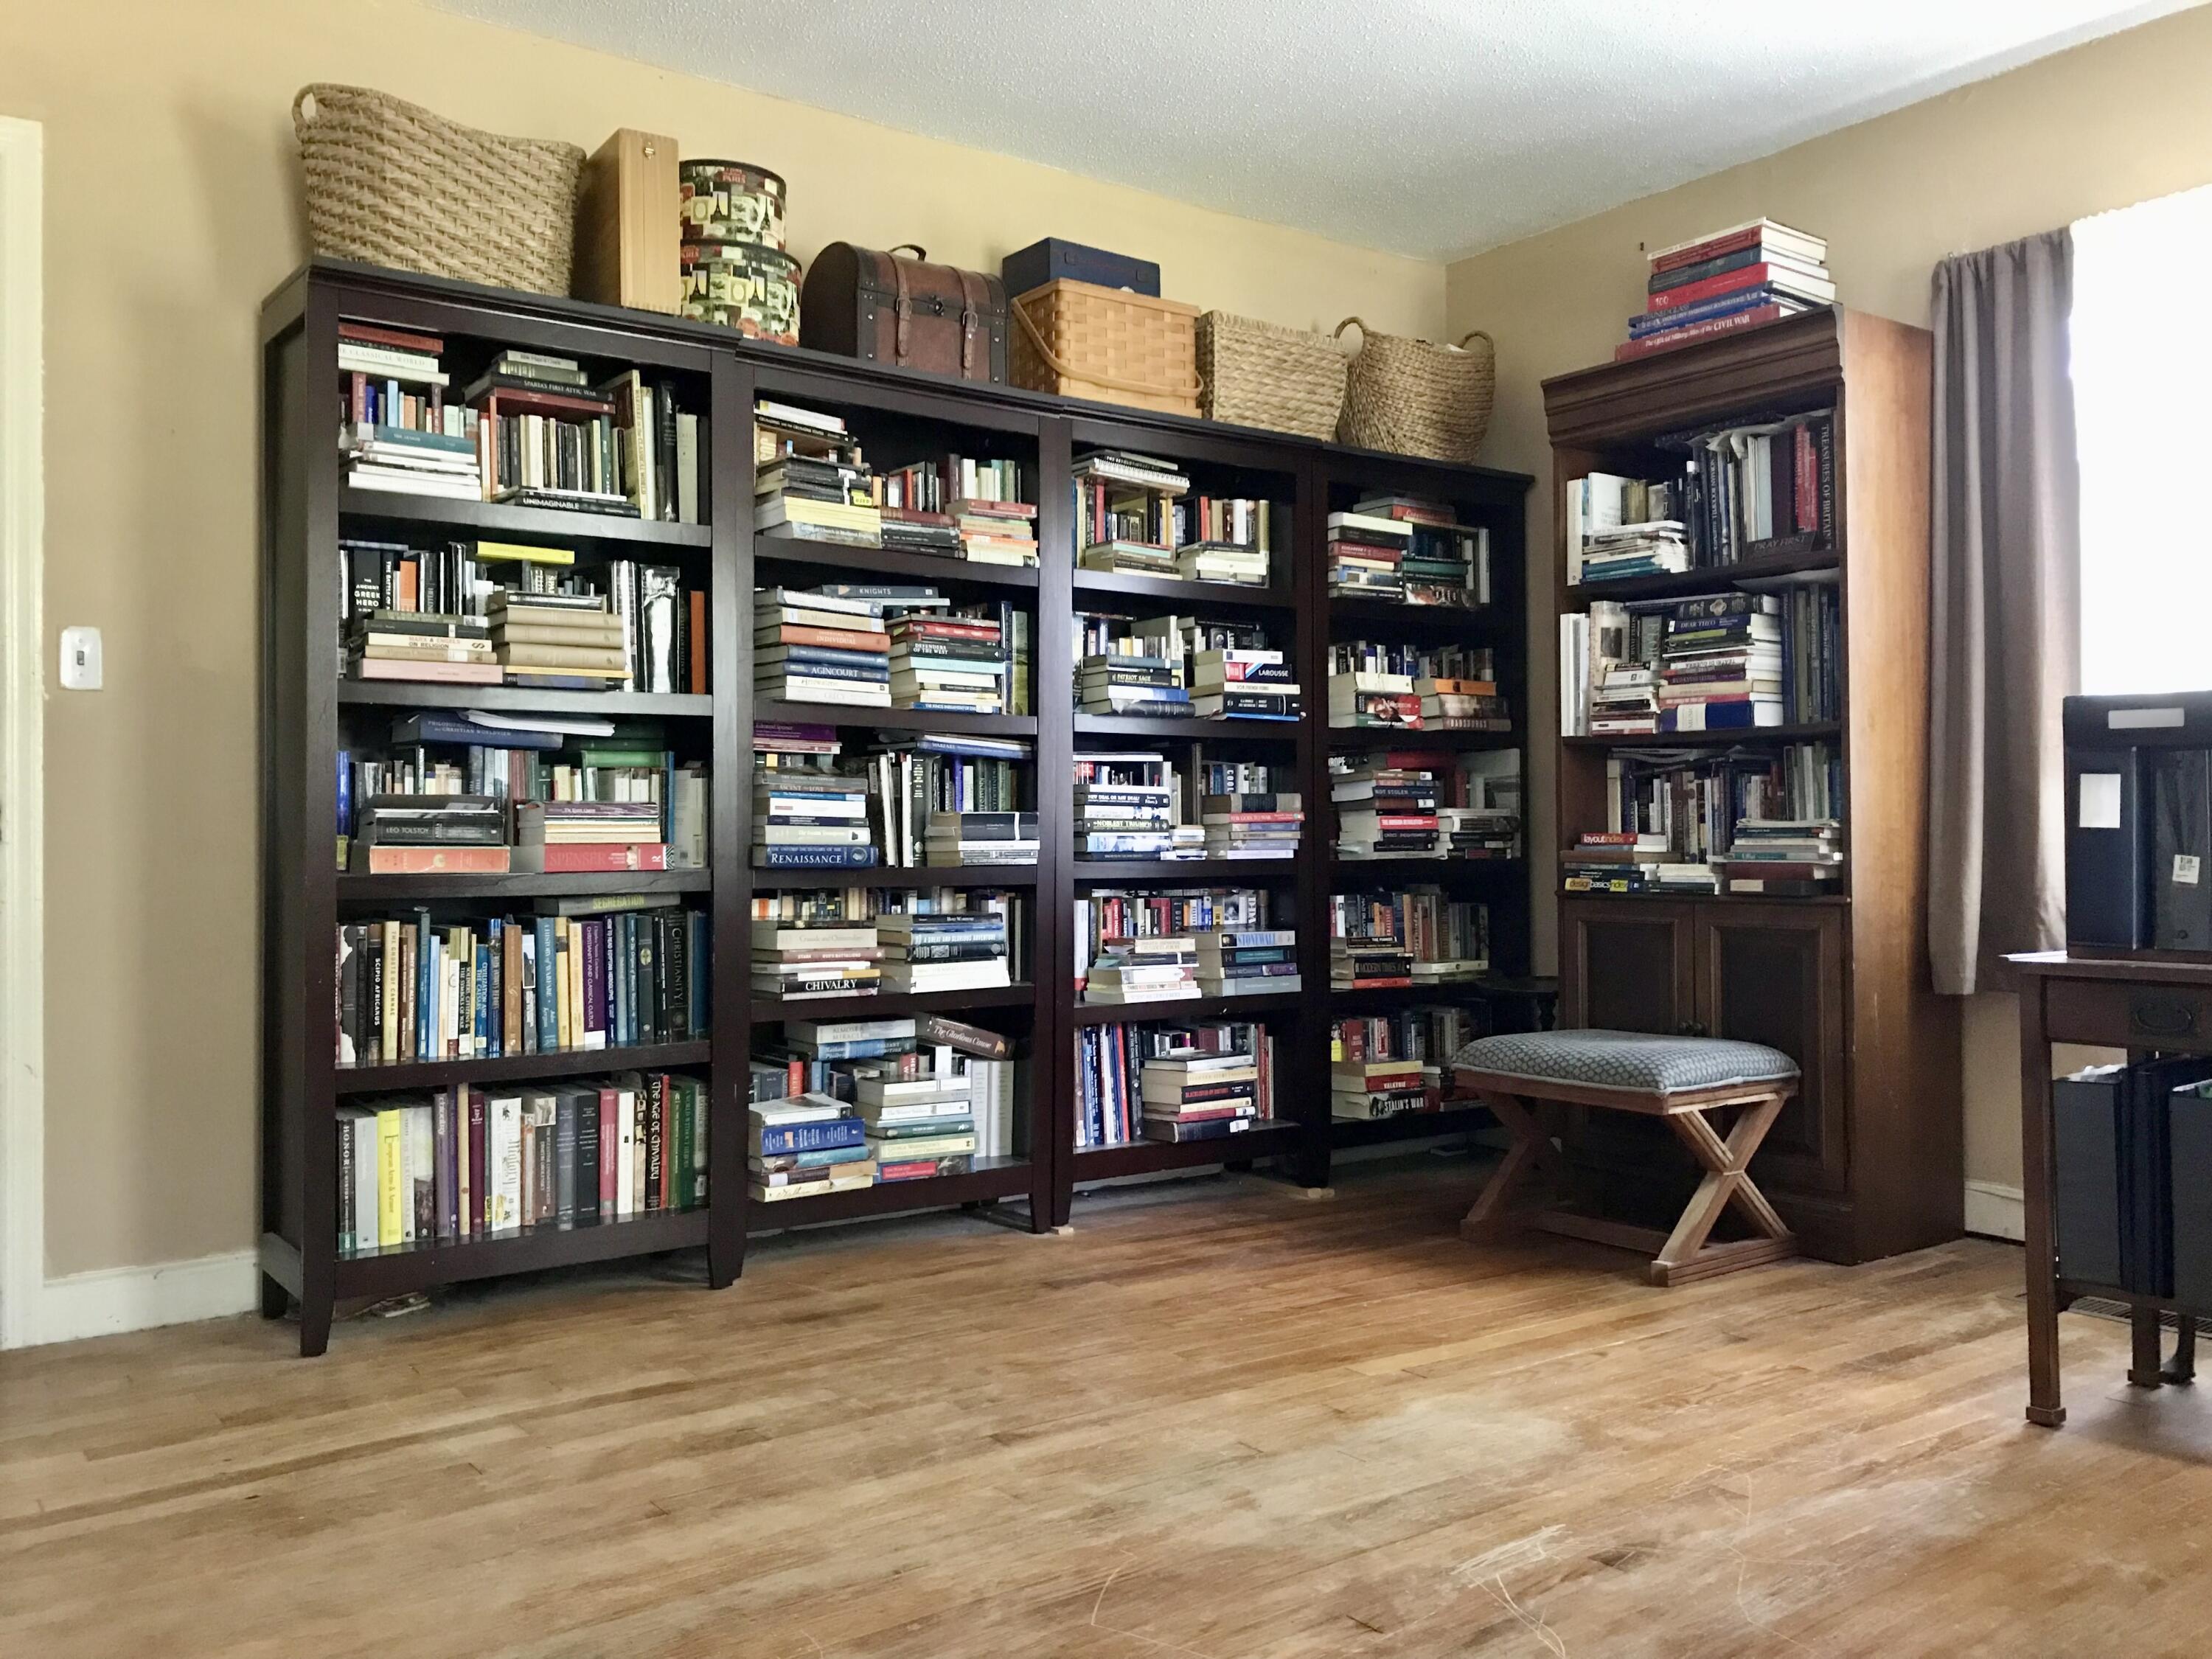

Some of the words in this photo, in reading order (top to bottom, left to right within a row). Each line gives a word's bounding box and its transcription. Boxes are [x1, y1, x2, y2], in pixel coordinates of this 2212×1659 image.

[1655, 296, 1669, 306] 100
[1714, 320, 1733, 331] CIVIL
[1734, 314, 1750, 324] WAR
[349, 349, 392, 361] CLASSICAL
[397, 355, 425, 366] WORLD
[566, 386, 581, 394] ATTIC
[1822, 424, 1830, 482] TREASURES
[1823, 484, 1830, 498] OF
[524, 498, 579, 509] UNIMAGINABLE
[1754, 540, 1779, 549] PRAY
[354, 591, 380, 599] GREEK
[385, 596, 391, 605] OF
[356, 599, 379, 607] HERO
[816, 636, 856, 644] INDIVIDUAL
[811, 667, 858, 678] AGINCOURT
[550, 852, 605, 866] SPENSER
[771, 853, 842, 863] RENAISSANCE
[593, 894, 644, 909] SEGREGATION
[672, 928, 683, 1001] CHRISTIANITY
[805, 979, 858, 991] CHIVALRY
[460, 1006, 465, 1015] OF
[933, 1026, 946, 1038] The
[946, 1029, 973, 1043] Glorious
[973, 1035, 992, 1048] Cause
[1383, 1081, 1406, 1089] VALKYRIE
[1384, 1099, 1409, 1111] STALIN'S
[1411, 1097, 1424, 1109] WAR
